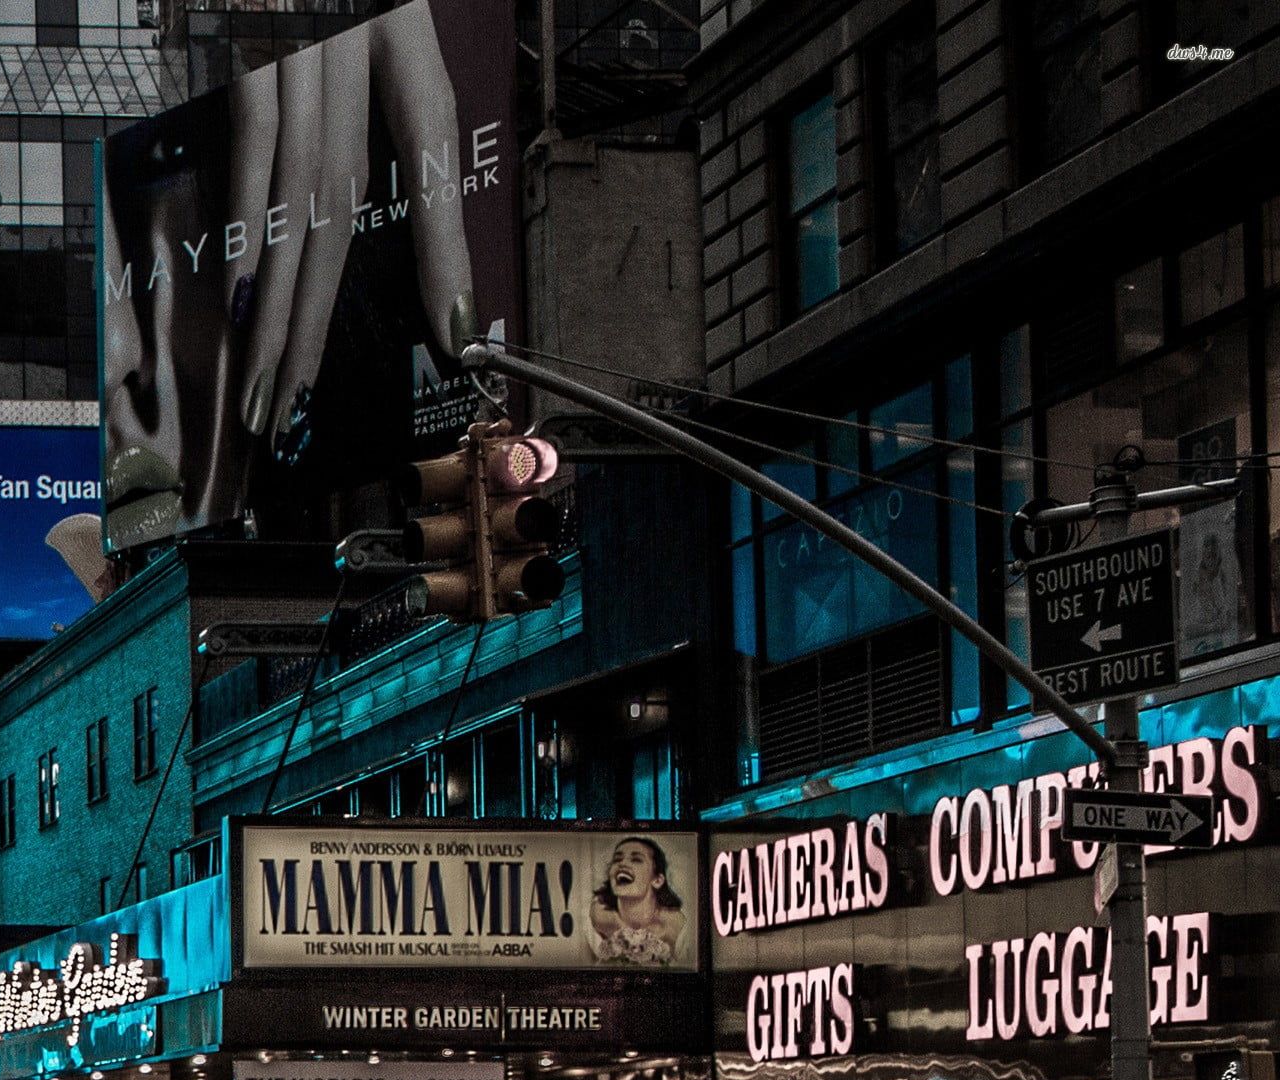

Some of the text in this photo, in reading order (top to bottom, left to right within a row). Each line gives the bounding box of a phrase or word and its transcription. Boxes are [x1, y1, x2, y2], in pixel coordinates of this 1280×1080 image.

[104, 121, 501, 307] MAYBELLINE
[351, 167, 500, 236] NEW YORK
[1035, 543, 1164, 595] SOUTHBOUND
[1046, 577, 1154, 623] USE 7 AVE
[1100, 652, 1166, 688] ROUTE
[930, 726, 1260, 897] COMPERS
[1084, 807, 1189, 830] ONE WAY
[310, 842, 348, 855] BENNY
[351, 843, 420, 856] ANDERSSON
[424, 844, 433, 856] &
[712, 812, 889, 937] CAMERAS
[259, 858, 574, 938] MAMMA MIA!
[303, 941, 451, 957] THE SMASH HIT MUSICAL
[321, 1005, 602, 1030] WINTER GARDEN THEATRE
[746, 962, 855, 1063] GIFTS
